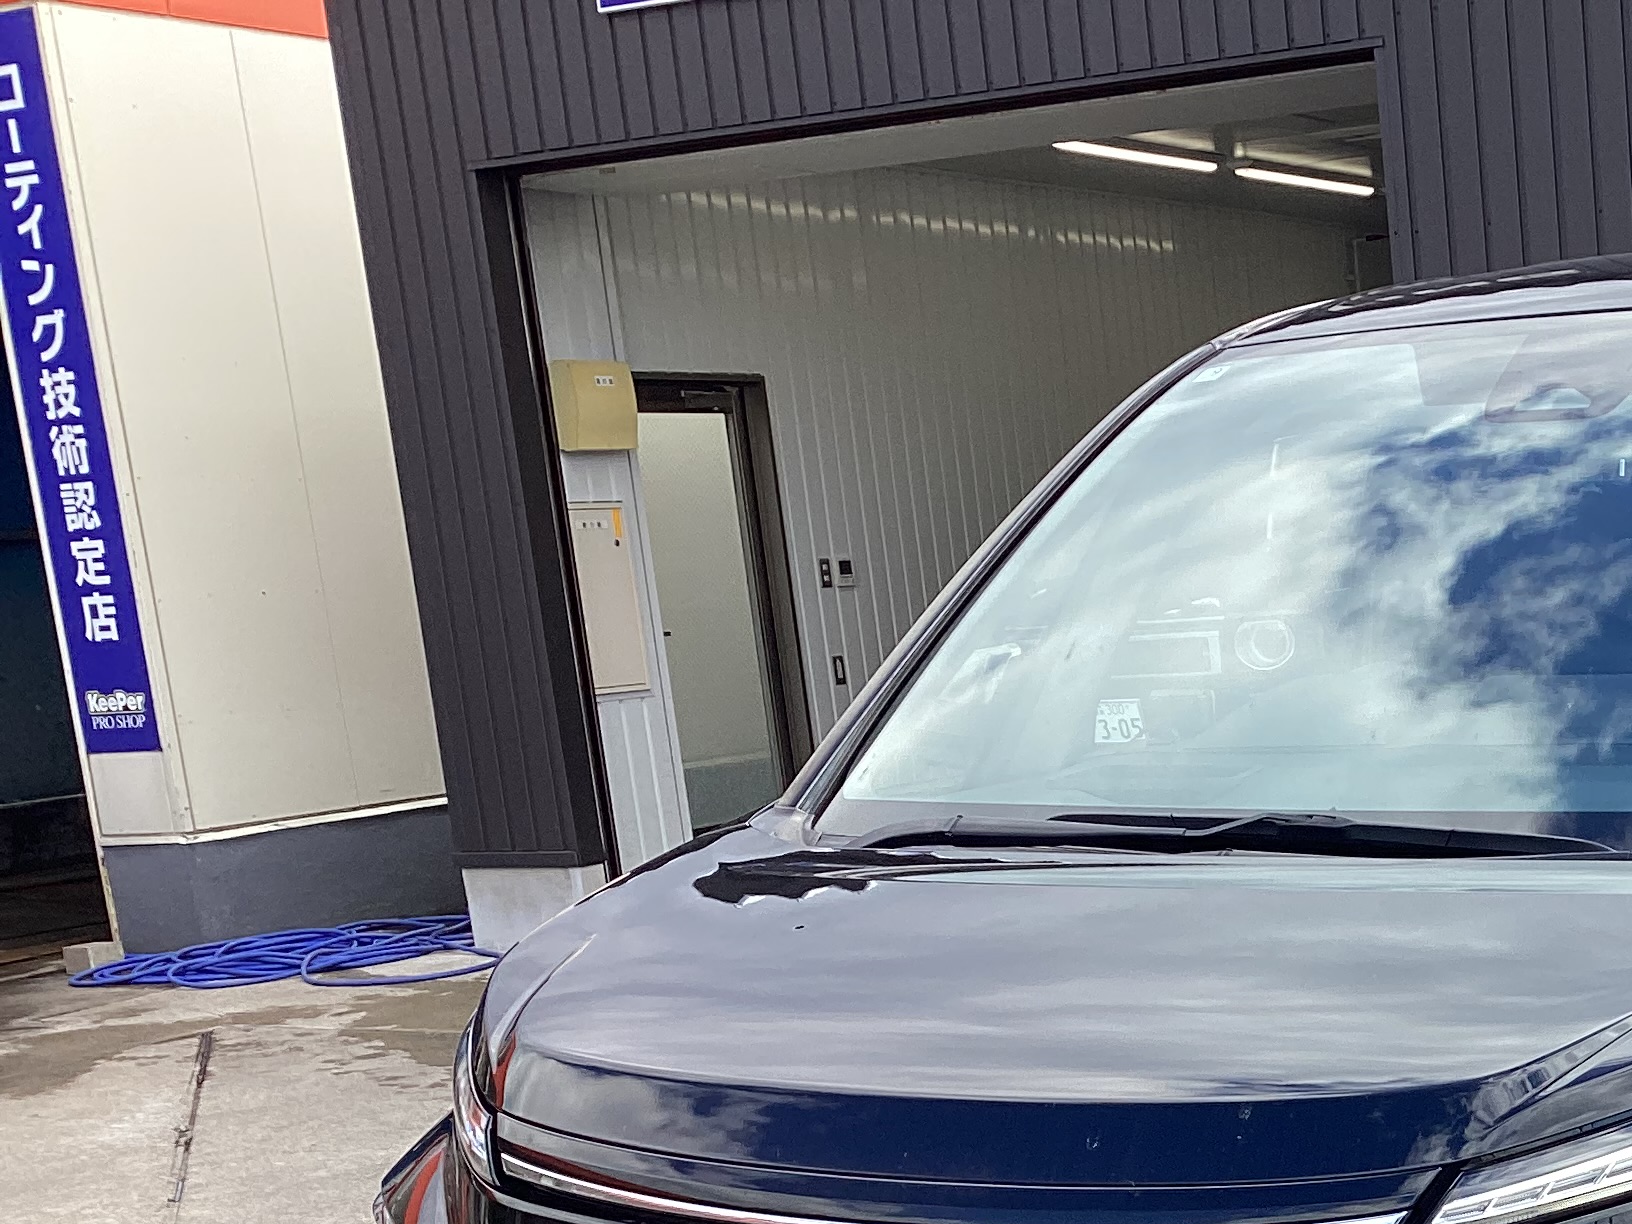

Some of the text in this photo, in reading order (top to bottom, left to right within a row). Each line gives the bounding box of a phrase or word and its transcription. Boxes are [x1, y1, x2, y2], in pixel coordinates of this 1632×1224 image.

[0, 63, 119, 642] コーティング技術認定店
[86, 689, 145, 714] KeePer
[91, 714, 146, 730] PRO SHOP
